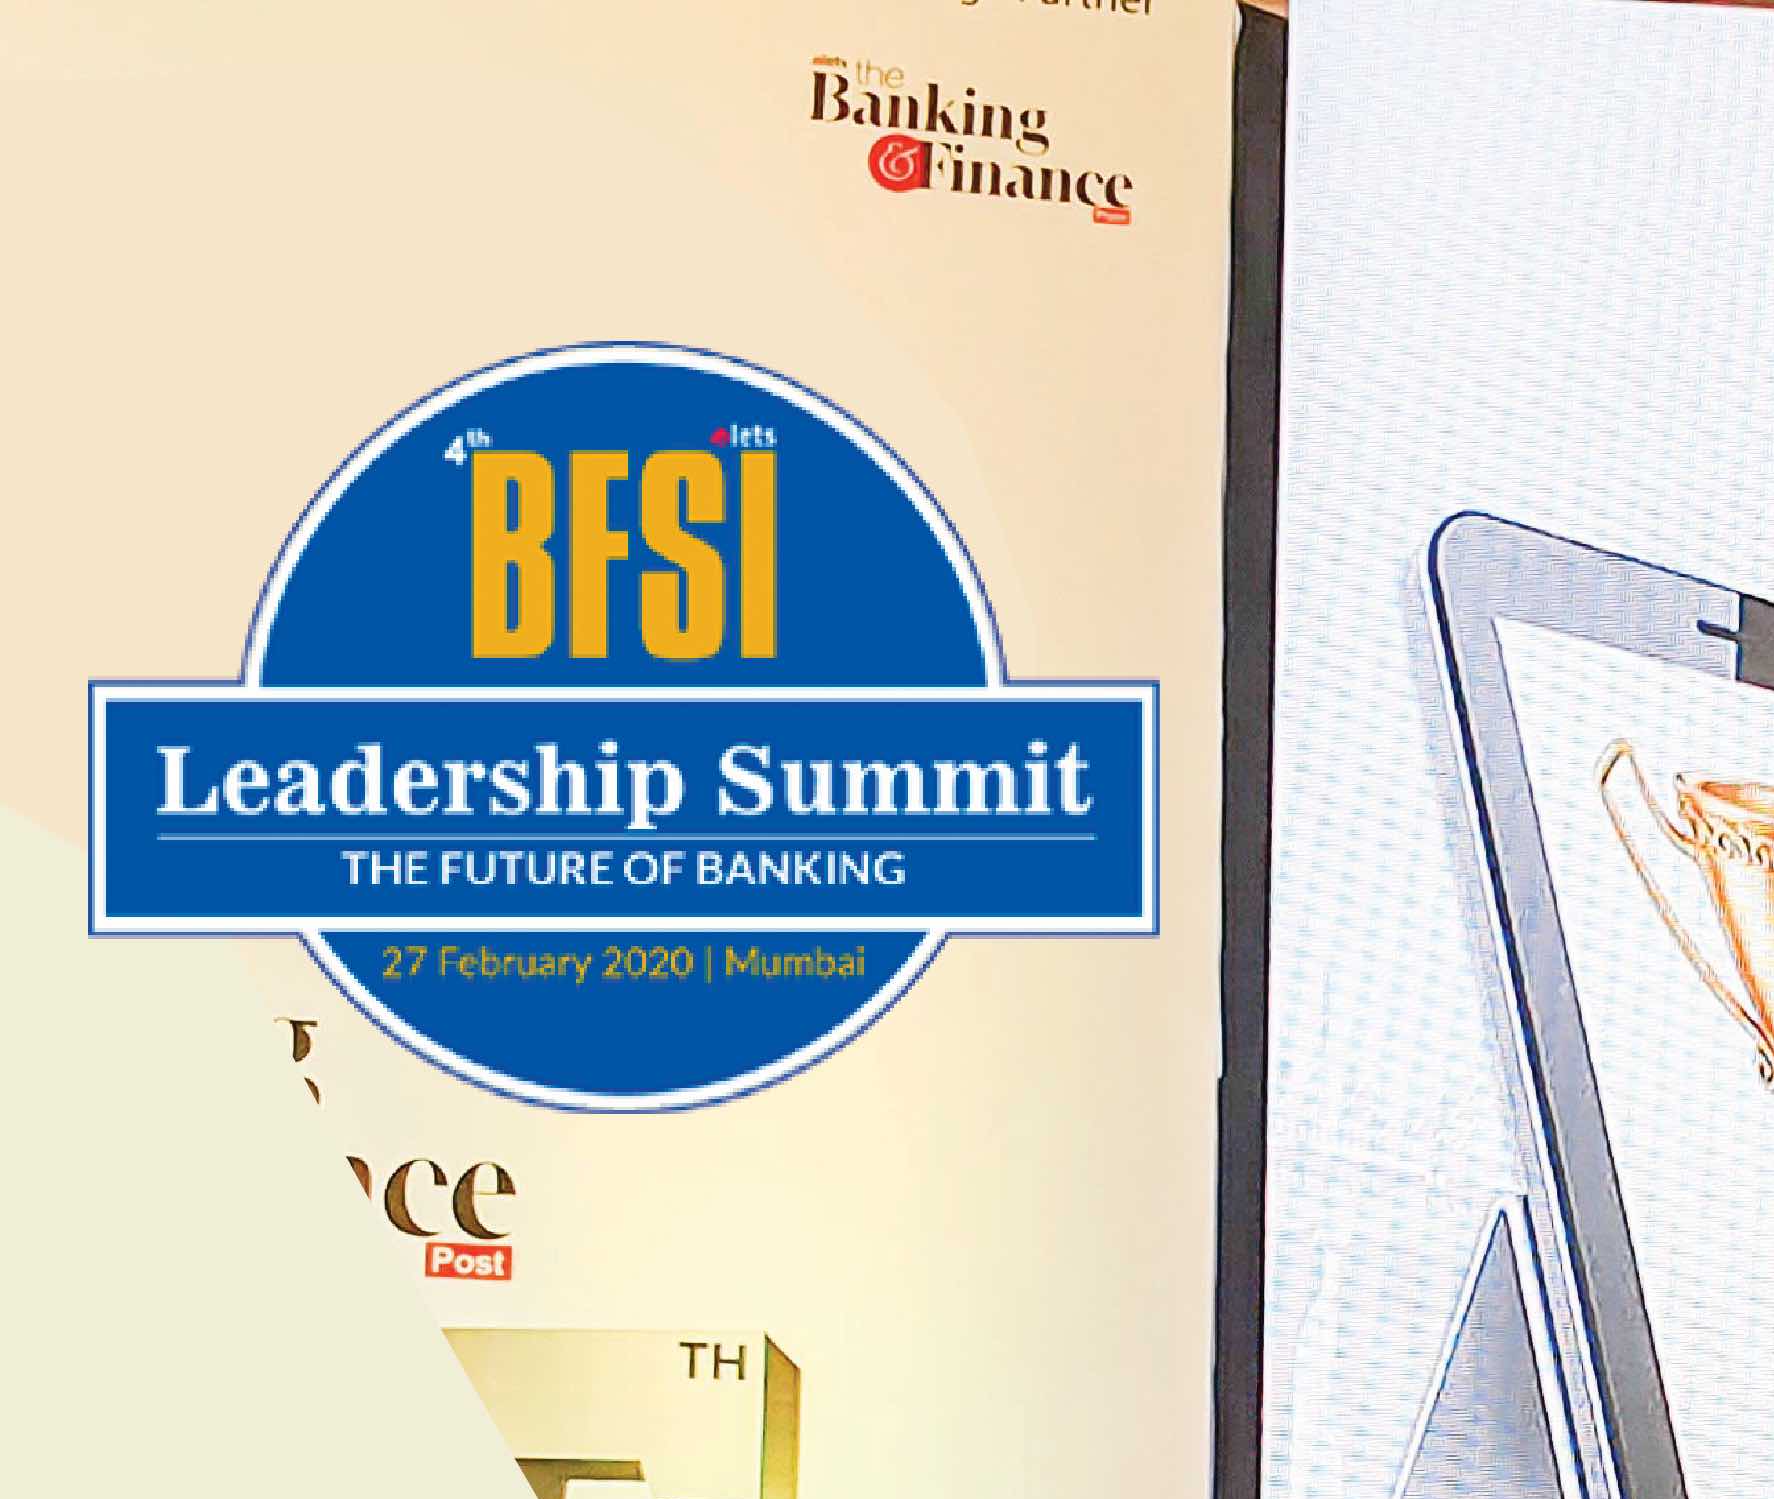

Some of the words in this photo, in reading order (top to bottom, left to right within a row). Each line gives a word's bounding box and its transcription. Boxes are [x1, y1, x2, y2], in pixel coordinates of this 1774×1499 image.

[856, 59, 904, 88] the
[811, 70, 1050, 156] Banking
[431, 1246, 506, 1276] Post
[679, 1342, 743, 1380] TH
